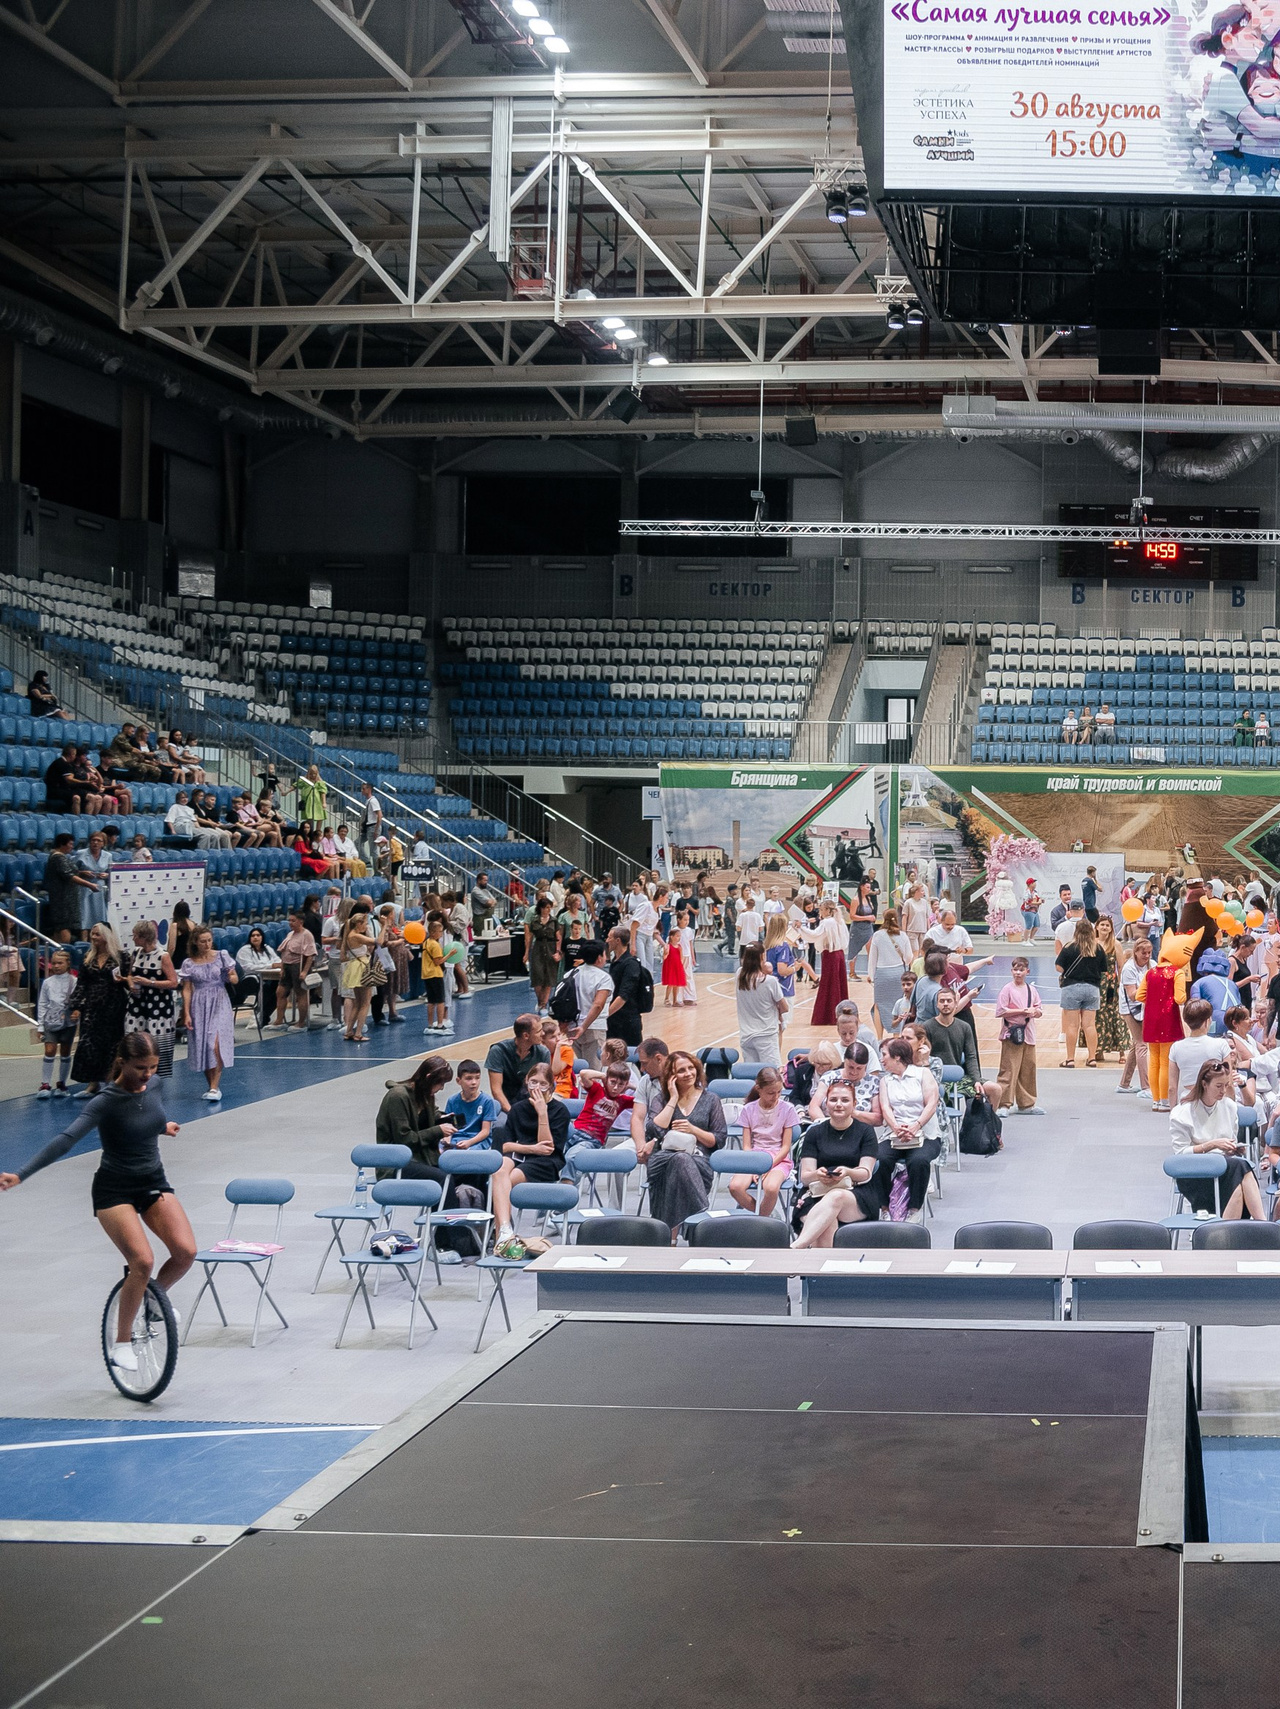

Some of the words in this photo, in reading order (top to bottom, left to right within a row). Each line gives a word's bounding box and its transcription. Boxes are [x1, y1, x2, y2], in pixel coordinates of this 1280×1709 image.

[891, 0, 988, 23] «Самая
[994, 7, 1082, 31] лучшая
[1087, 7, 1171, 26] семья»
[1063, 48, 1115, 56] ВЫСТУПЛЕНИЕ
[1116, 49, 1153, 57] АРТИСТОВ
[1003, 58, 1054, 66] ПОБЕДИТЕЛЕЙ
[1054, 59, 1100, 68] НОМИНАЦИЙ
[913, 98, 975, 108] ЭСТЕТИКА
[1009, 90, 1049, 119] 30
[1055, 92, 1161, 129] августа
[920, 110, 968, 120] УСПЕХА
[1045, 129, 1127, 158] 15:00
[926, 149, 975, 161] ЛУЧШИЙ
[1146, 543, 1177, 559] 14:59
[709, 582, 772, 597] СЕКТОР
[1131, 589, 1195, 604] СЕКТОР
[730, 771, 798, 787] Брянщина
[1046, 775, 1080, 791] край
[1083, 776, 1144, 792] трудовой
[1146, 779, 1155, 791] и
[1158, 776, 1222, 791] воинской
[476, 1105, 483, 1115] 6
